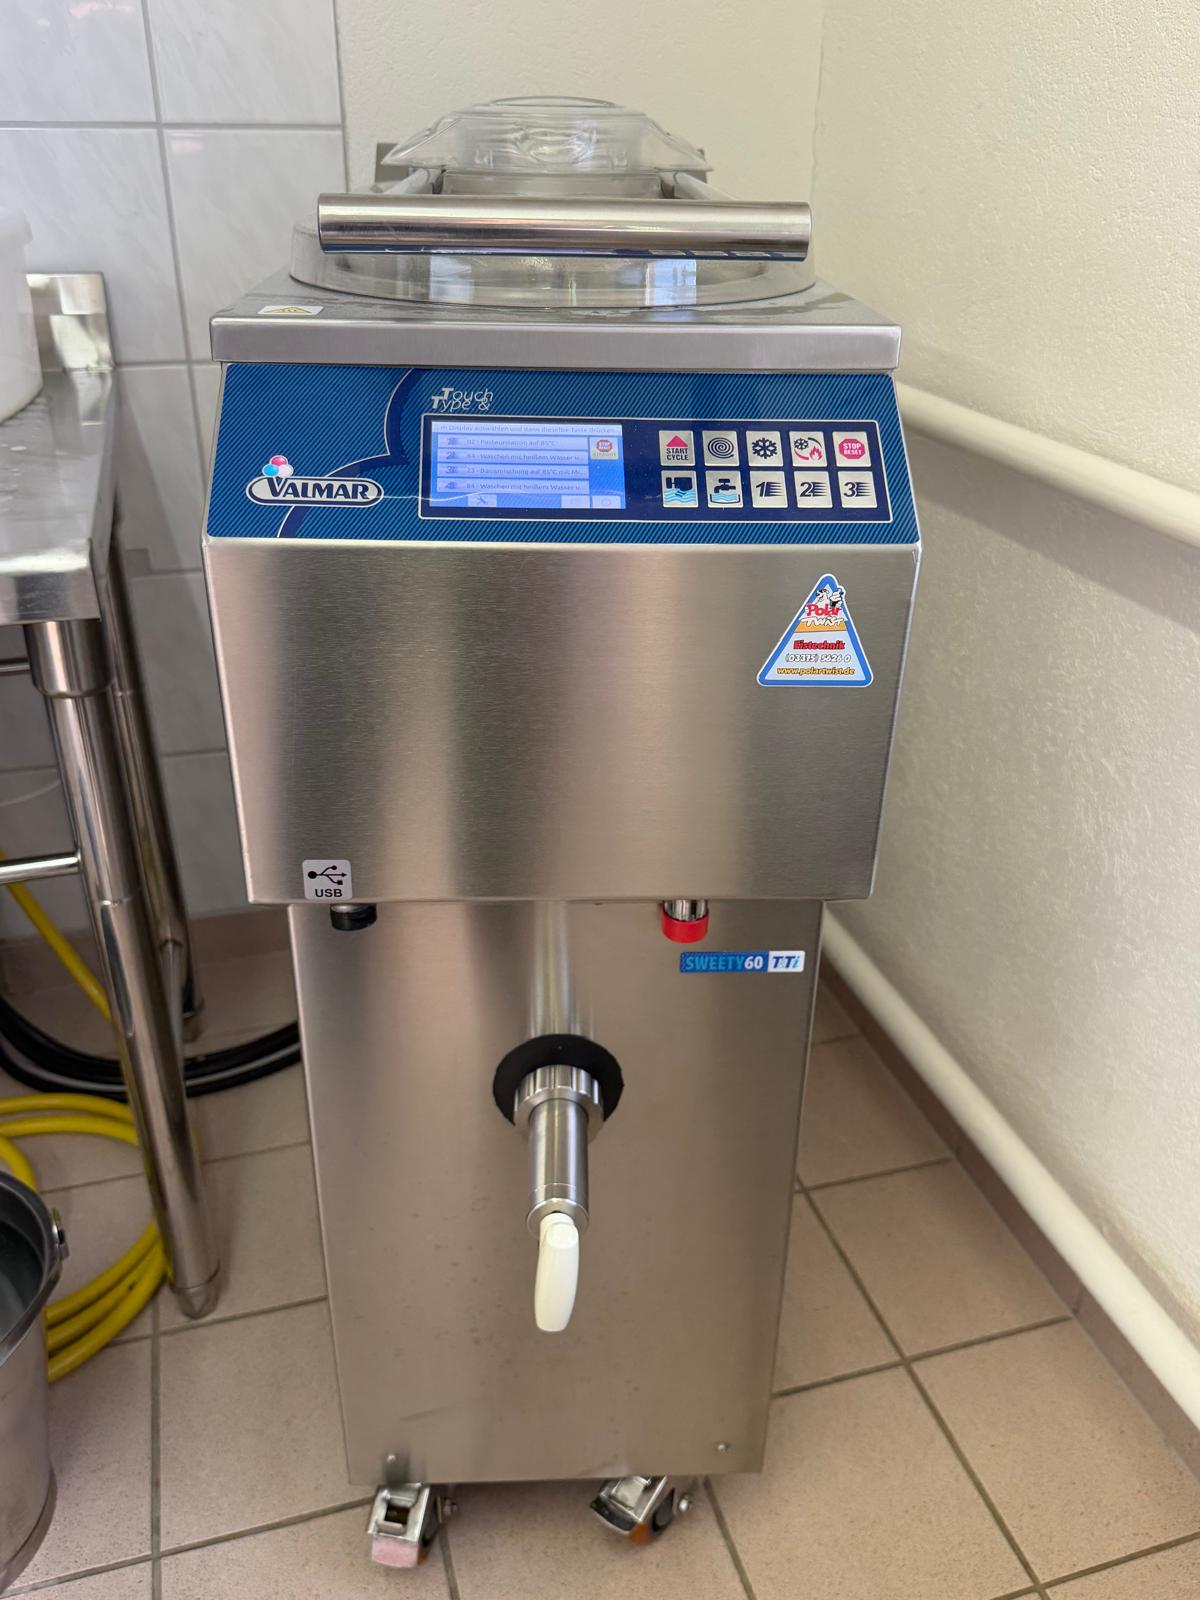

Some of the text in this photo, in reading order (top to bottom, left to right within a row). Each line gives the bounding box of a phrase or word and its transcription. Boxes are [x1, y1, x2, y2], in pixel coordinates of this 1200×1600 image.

[442, 388, 494, 402] Touch
[432, 396, 490, 412] Type &
[266, 478, 370, 499] VALMAR
[755, 481, 766, 497] 1
[800, 481, 814, 498] 2
[843, 481, 857, 498] 3
[806, 603, 842, 616] Polar
[793, 640, 846, 650] Eistechnik
[844, 654, 852, 663] 0
[777, 666, 856, 676] www.polartwist.de
[315, 889, 342, 897] USB
